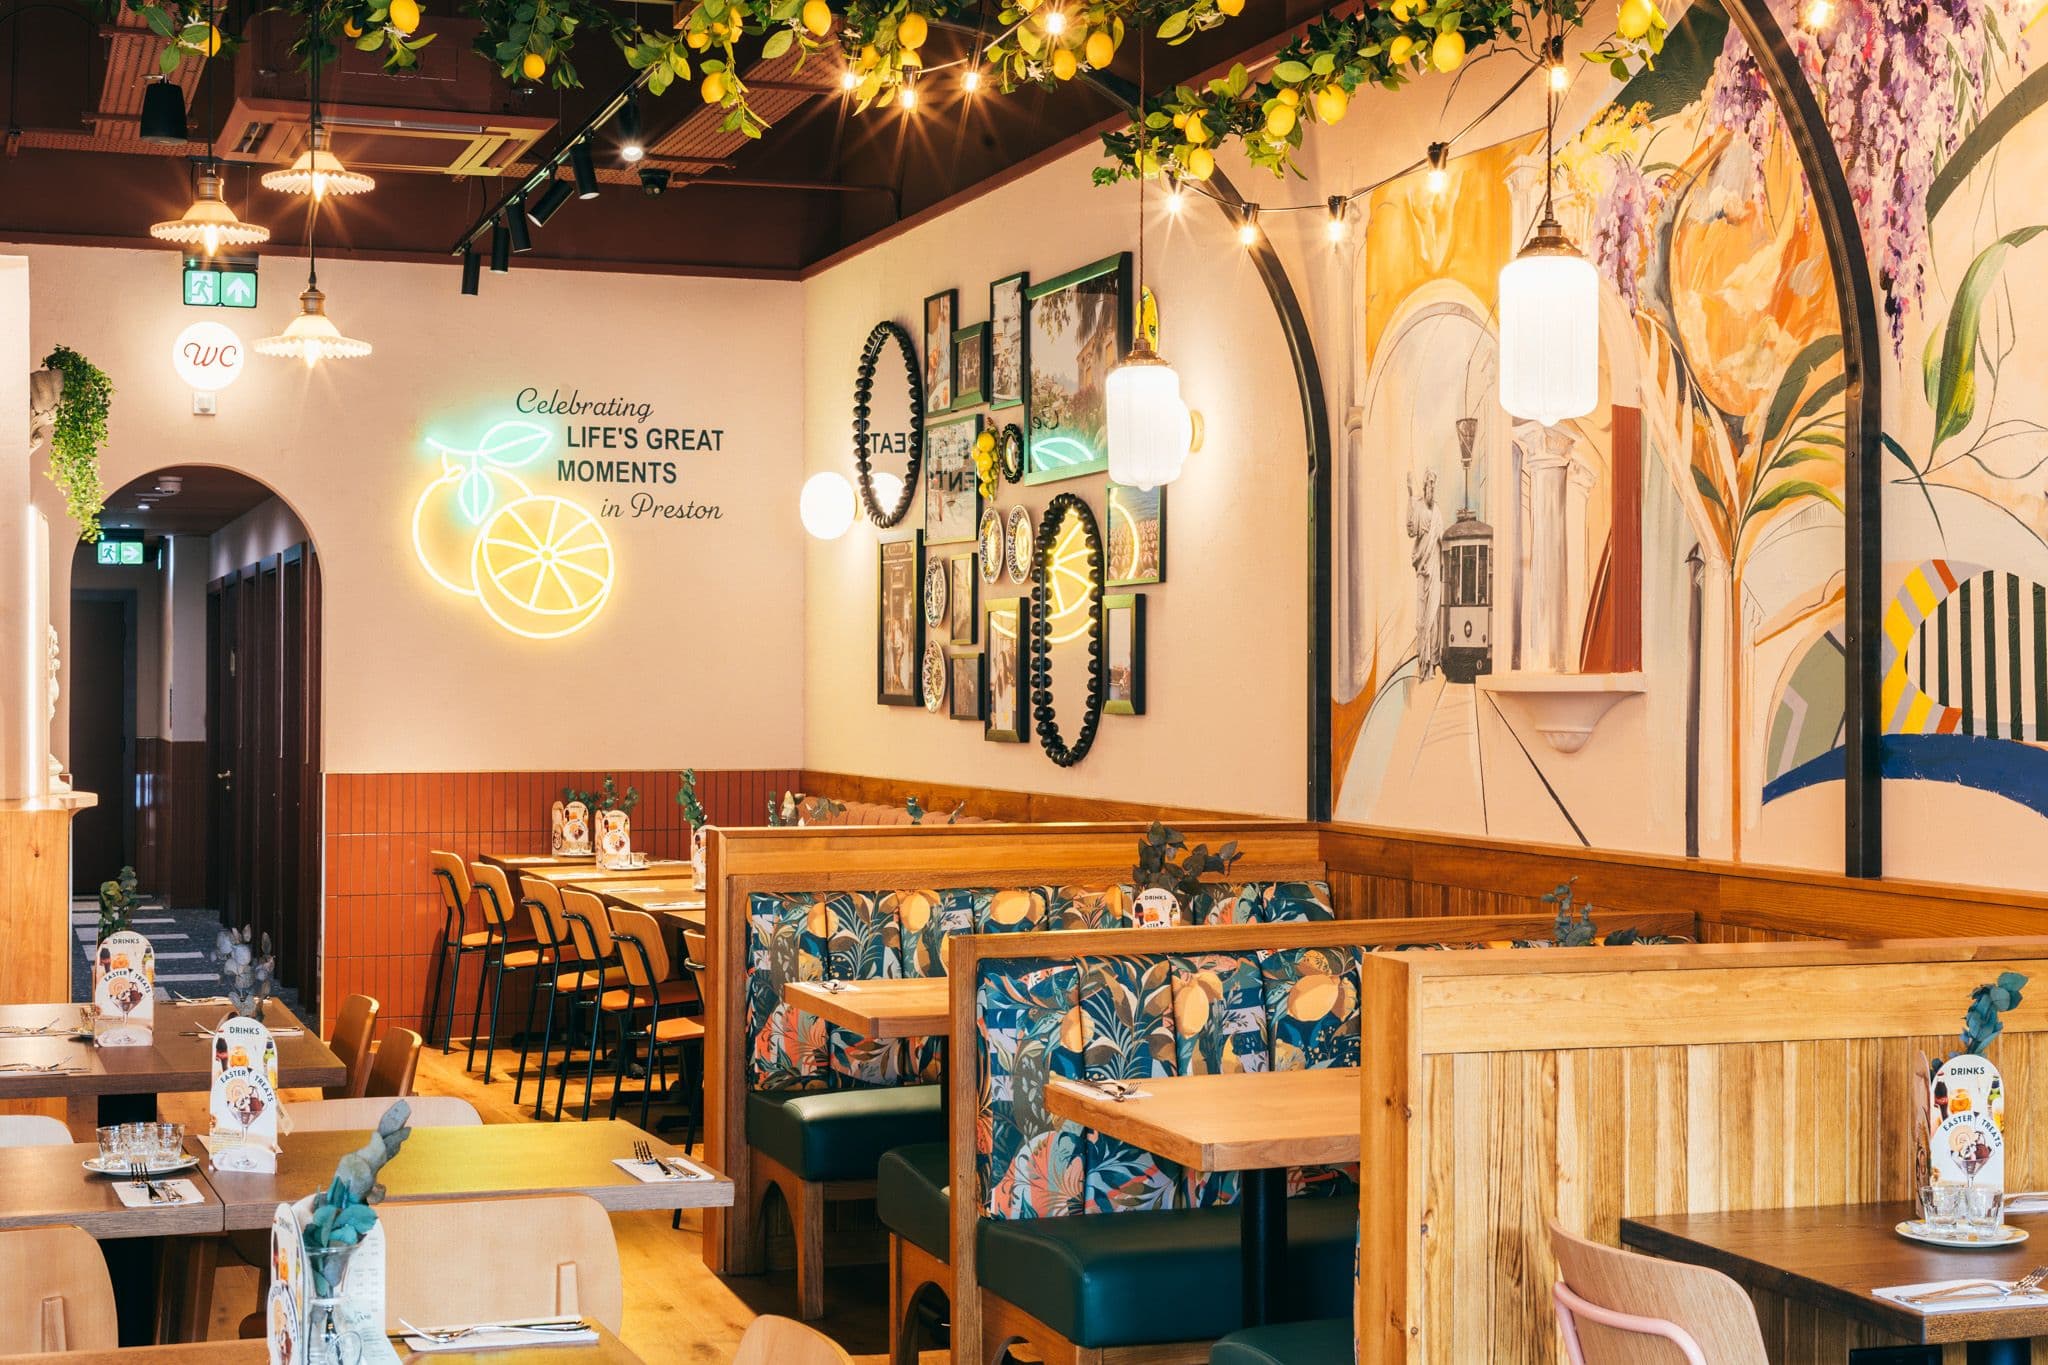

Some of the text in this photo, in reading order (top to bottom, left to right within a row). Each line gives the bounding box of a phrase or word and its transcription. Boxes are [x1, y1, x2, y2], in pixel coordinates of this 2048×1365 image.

[183, 342, 237, 367] WC
[516, 387, 654, 423] Celebrating
[567, 426, 724, 451] LIFE'S GREAT
[557, 460, 677, 484] MOMENTS
[600, 492, 723, 520] in Preston
[104, 970, 151, 994] EASTER TREATS
[229, 1026, 260, 1035] DRINKS
[1951, 1066, 1985, 1076] DRINKS
[220, 1069, 273, 1102] EASTER TREATS
[1943, 1114, 2002, 1147] EASTER TREATS
